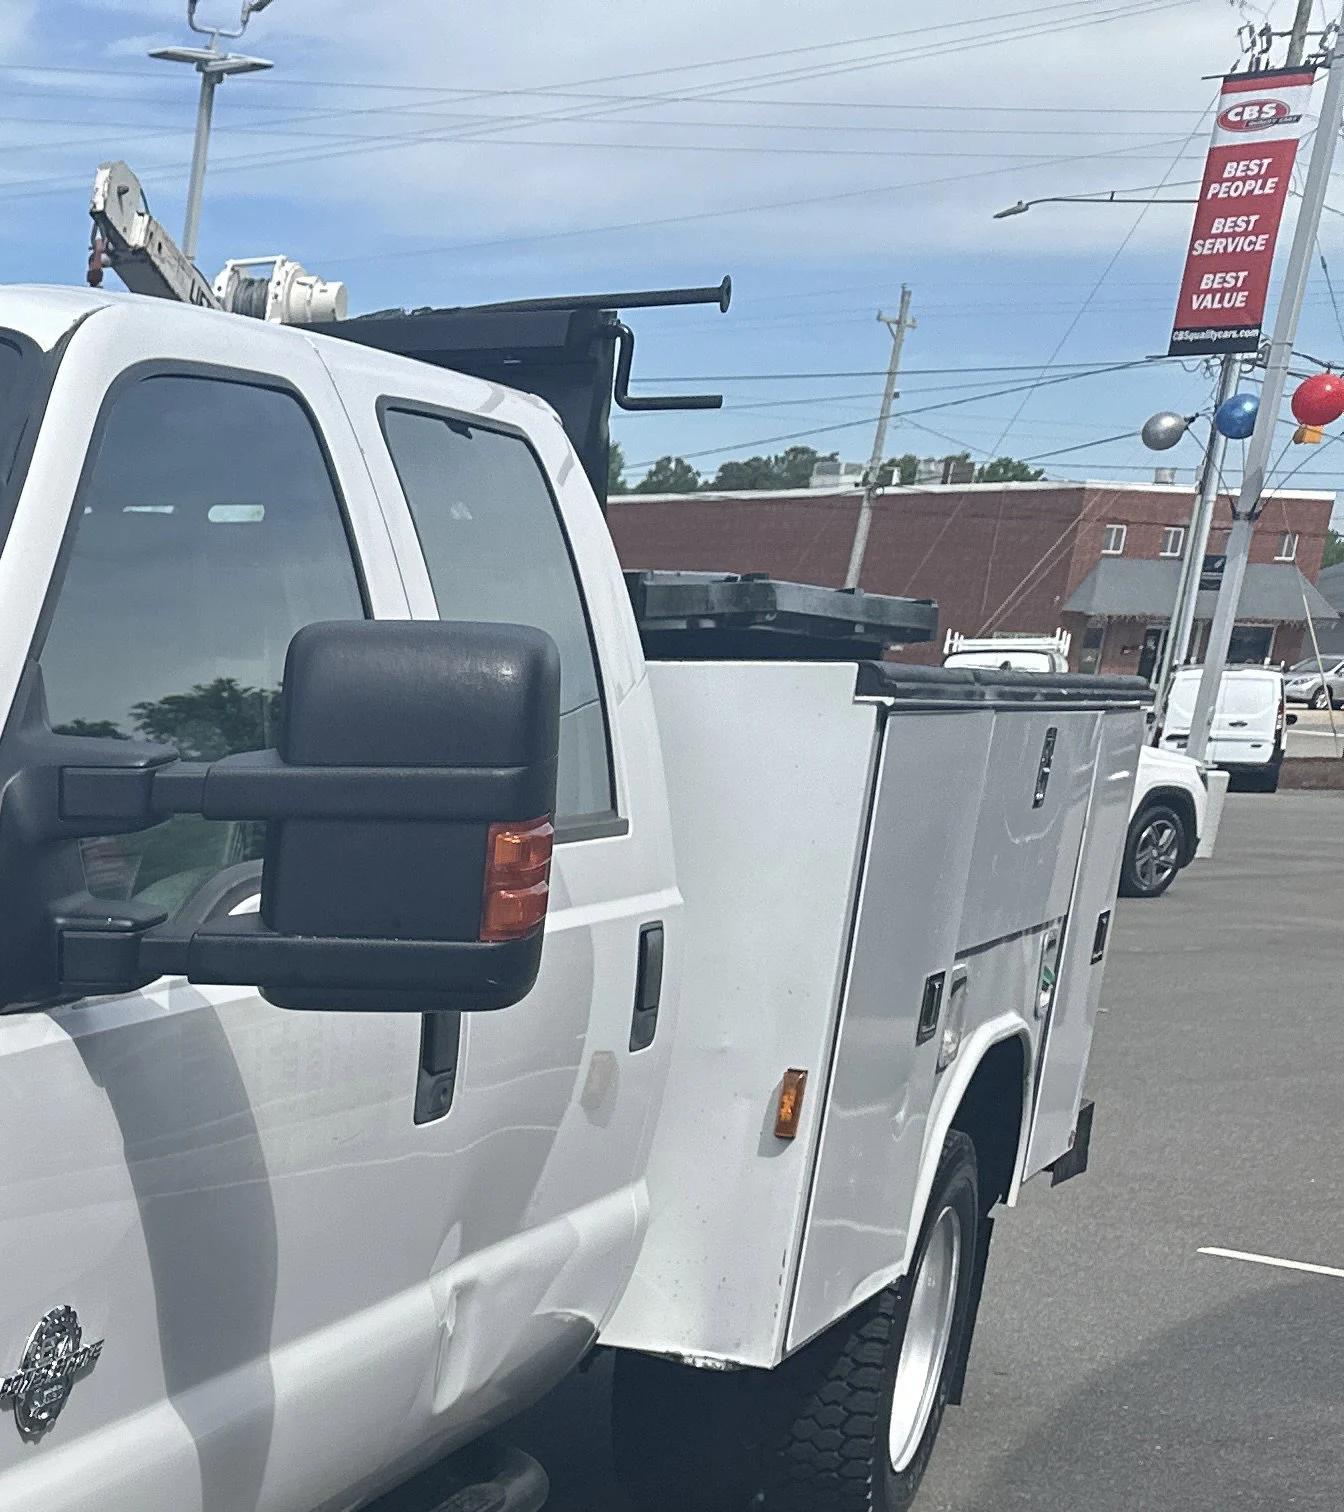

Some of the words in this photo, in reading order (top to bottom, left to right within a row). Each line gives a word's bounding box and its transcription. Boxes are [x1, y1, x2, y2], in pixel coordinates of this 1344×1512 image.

[1228, 103, 1277, 121] CBS
[1222, 158, 1272, 178] BEST
[1207, 177, 1279, 199] PEOPLE
[1211, 215, 1260, 235] BEST
[1192, 234, 1269, 256] SERVICE
[1200, 271, 1248, 290] BEST
[1191, 291, 1249, 310] VALUE
